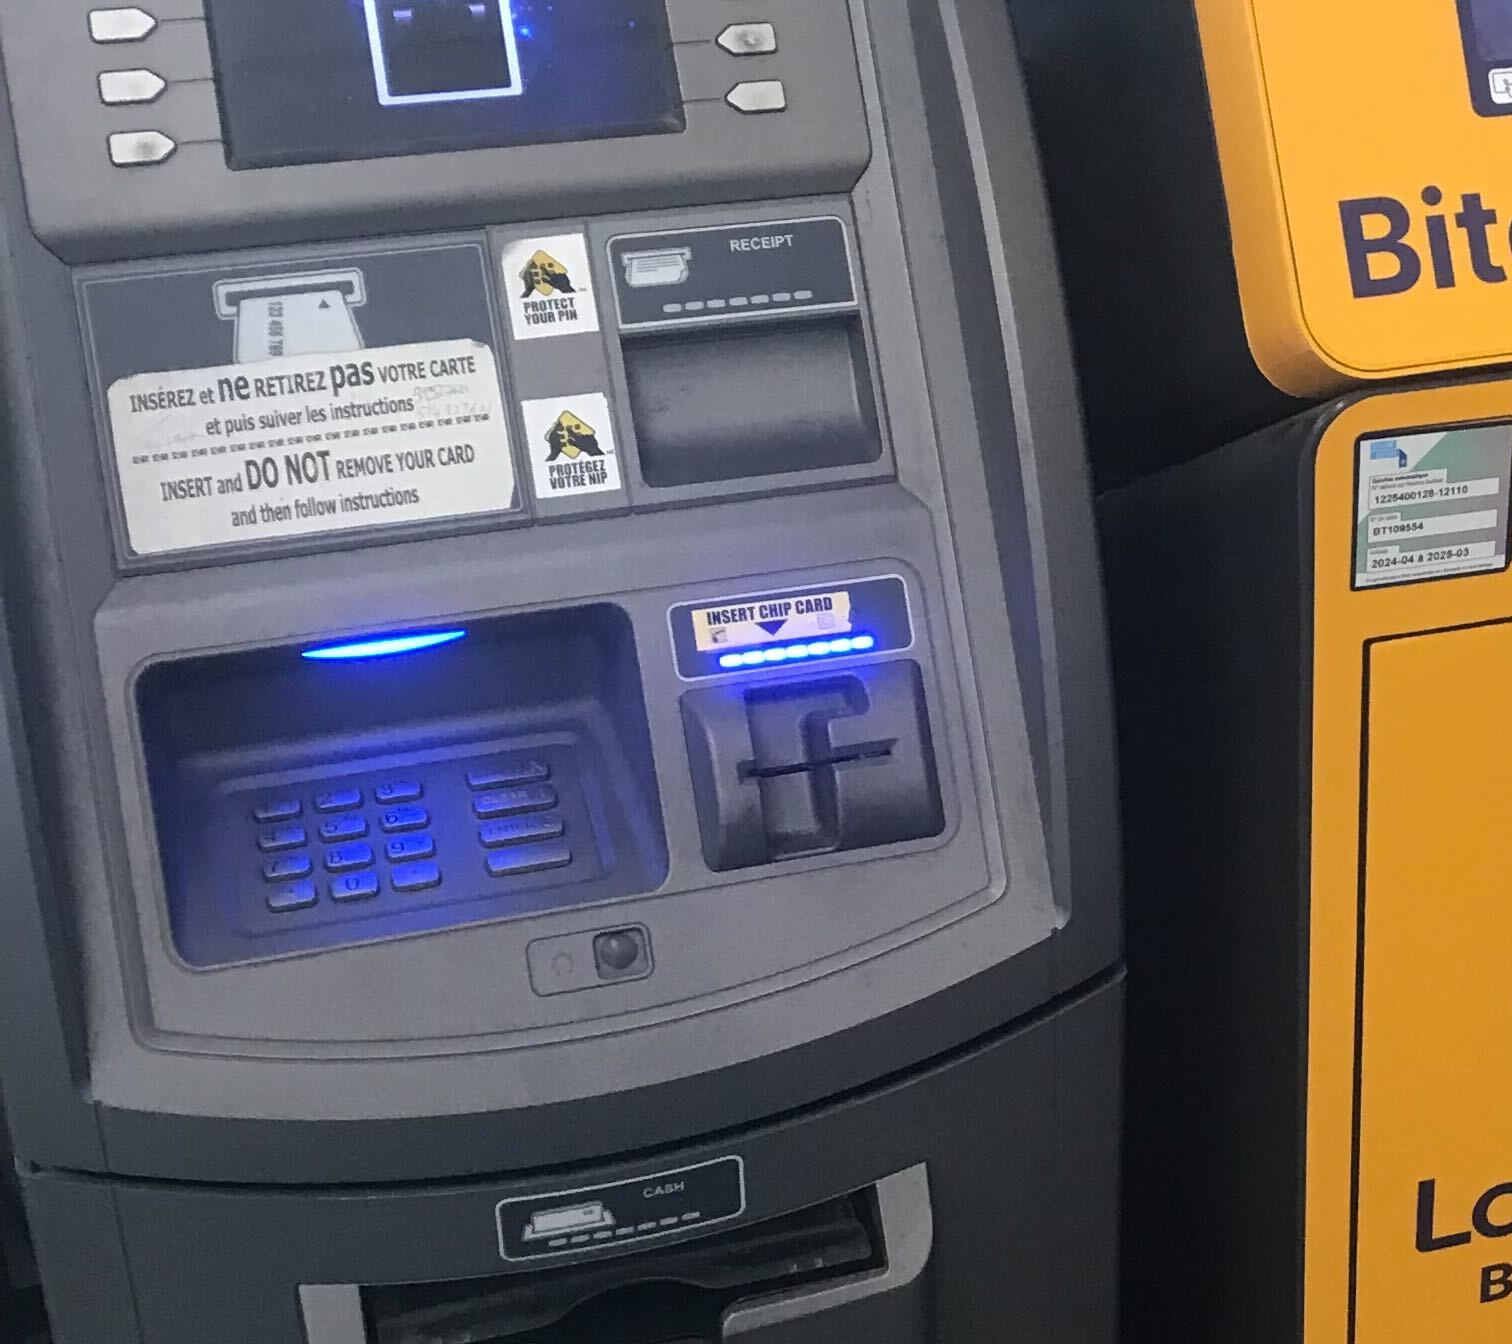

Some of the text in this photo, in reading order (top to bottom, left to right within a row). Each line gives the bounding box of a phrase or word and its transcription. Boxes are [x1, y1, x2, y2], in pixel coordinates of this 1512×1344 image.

[729, 235, 794, 253] RECEIPT
[523, 297, 575, 313] PROTECT
[524, 309, 578, 325] YOUR PIN
[129, 355, 476, 413] INSÉREZ et ne RETIREZ pas VOTRE CARTE
[205, 396, 414, 437] et puis suiver les instructions
[160, 444, 475, 501] INSERT and DO NOT REMOVE YOUR CARD
[548, 460, 606, 478] PROTÉGEZ
[549, 472, 608, 489] VOTRE NIP
[231, 487, 419, 527] and then follow instructions
[706, 597, 834, 627] INSERT CHIP CARD
[642, 1181, 685, 1200] CASH
